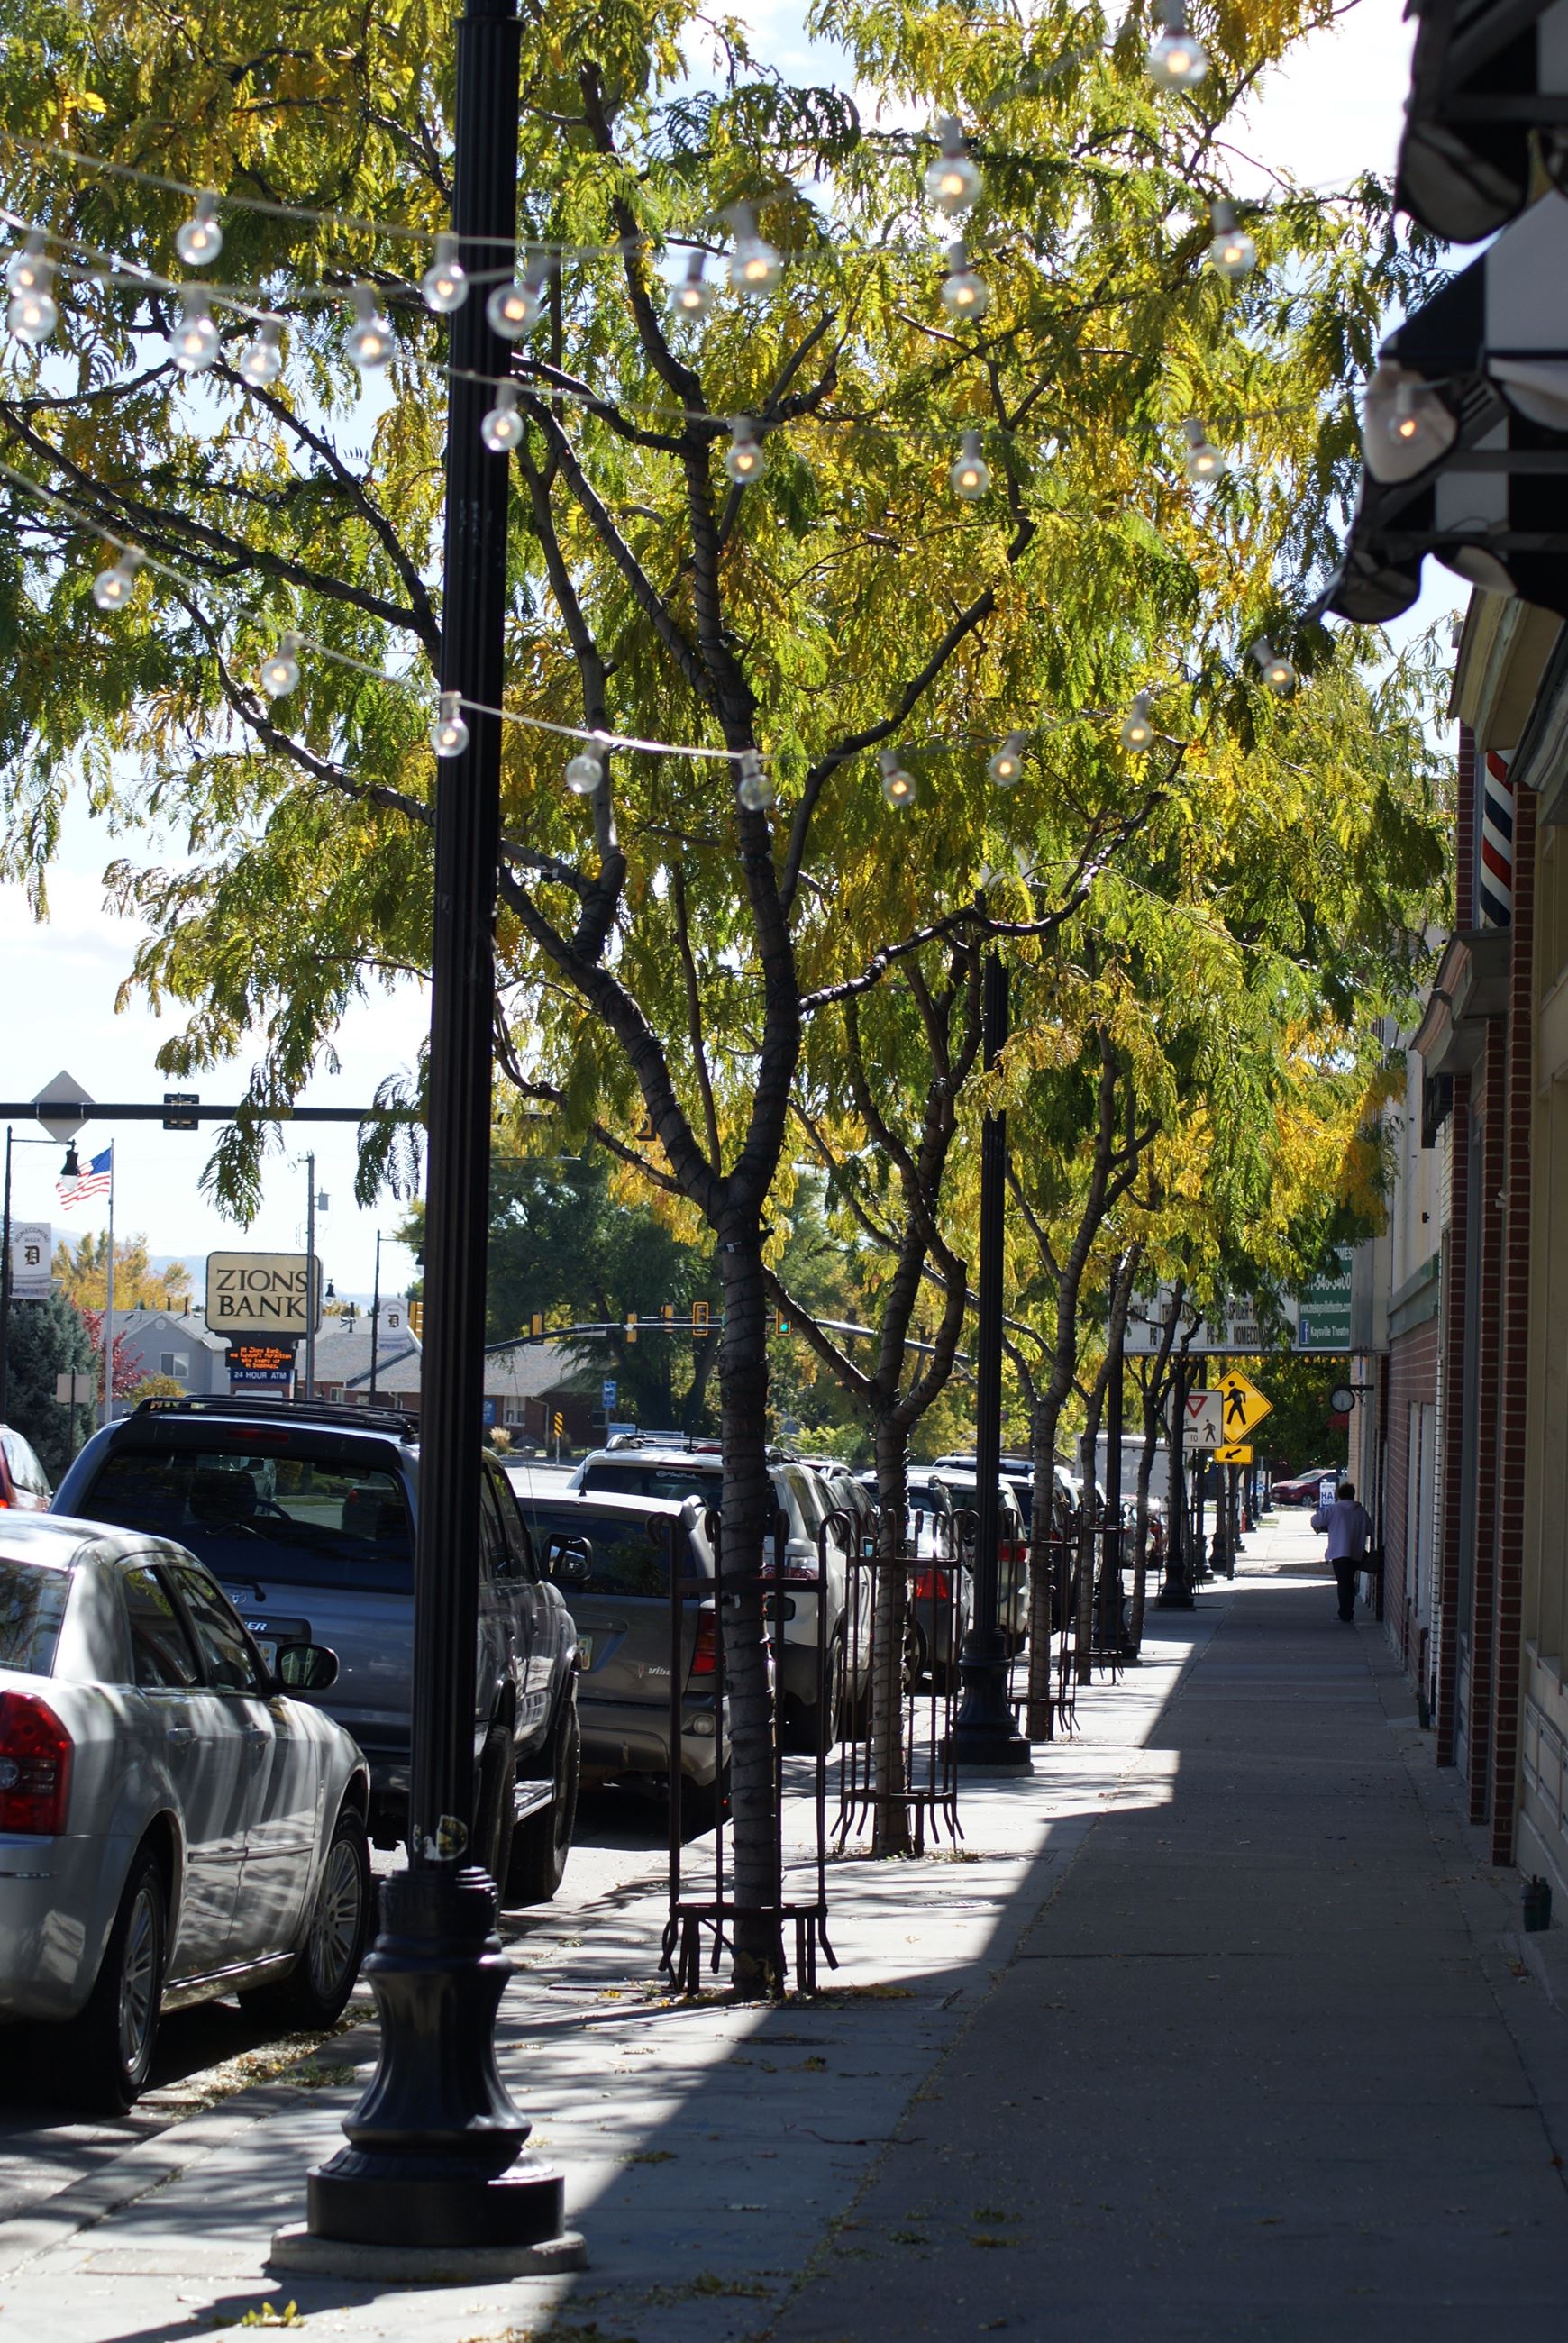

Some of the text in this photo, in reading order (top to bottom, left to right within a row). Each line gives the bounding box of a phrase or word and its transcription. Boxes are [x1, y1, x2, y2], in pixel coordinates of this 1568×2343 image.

[14, 1227, 50, 1244] HOMECOMING
[24, 1245, 40, 1265] D
[215, 1269, 308, 1293] ZIONS
[217, 1295, 308, 1318] BANK
[1332, 1326, 1350, 1336] Theatre
